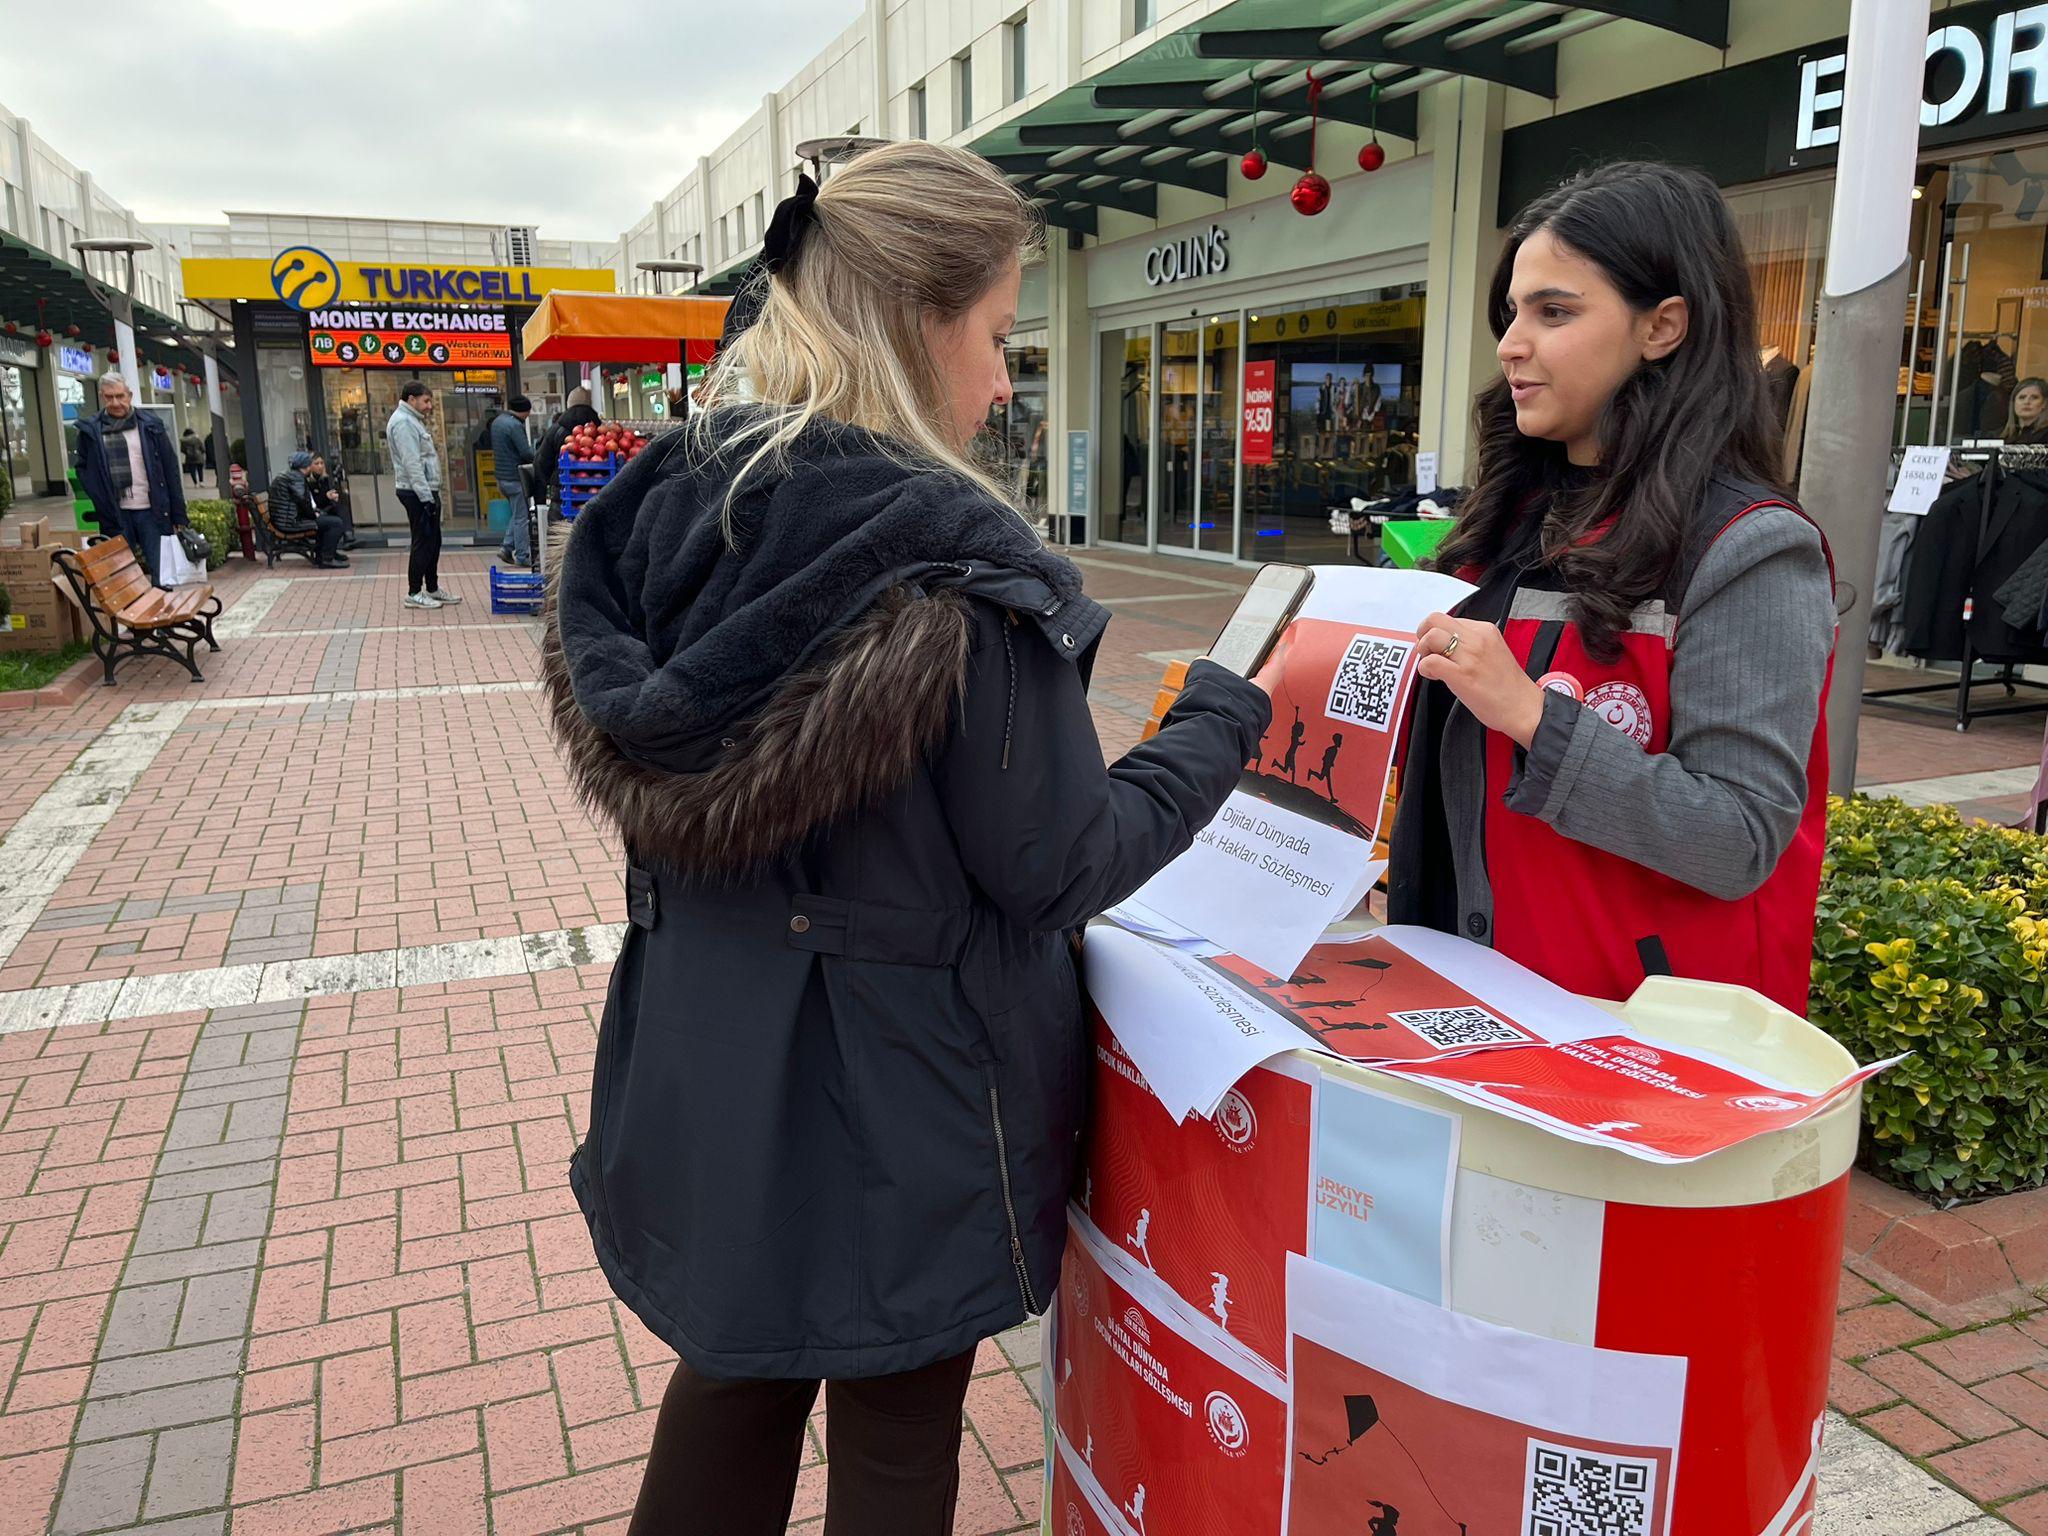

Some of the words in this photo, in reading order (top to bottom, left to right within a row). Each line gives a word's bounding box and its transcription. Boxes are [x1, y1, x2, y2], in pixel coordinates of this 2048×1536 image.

[1145, 224, 1229, 286] COLIN'S
[359, 267, 542, 301] TURKCELL
[309, 310, 389, 331] MONEY
[391, 311, 507, 332] EXCHANGE
[446, 340, 490, 349] Western
[461, 349, 490, 358] Union
[1244, 407, 1273, 433] %50
[1911, 455, 1938, 465] CEKET
[1904, 470, 1938, 482] 1650,00
[1911, 486, 1920, 496] TL
[1222, 806, 1257, 832] Dijital
[1255, 821, 1311, 857] Dünyada
[1215, 834, 1258, 865] Hakları
[1258, 854, 1335, 898] Sözleşmesi
[1116, 1059, 1148, 1091] HAKLARI
[1557, 1046, 1619, 1071] HAKLARI
[1616, 1066, 1708, 1100] SÖZLEŞMESİ
[1610, 1056, 1678, 1083] DÜNYADA
[1107, 1316, 1132, 1349] DİJİTAL
[1132, 1340, 1169, 1382] DÜNYADA
[1094, 1316, 1113, 1347] ÇOCUK
[1112, 1341, 1143, 1378] HAKLARI
[1142, 1368, 1193, 1419] SÖZLEŞMESİ
